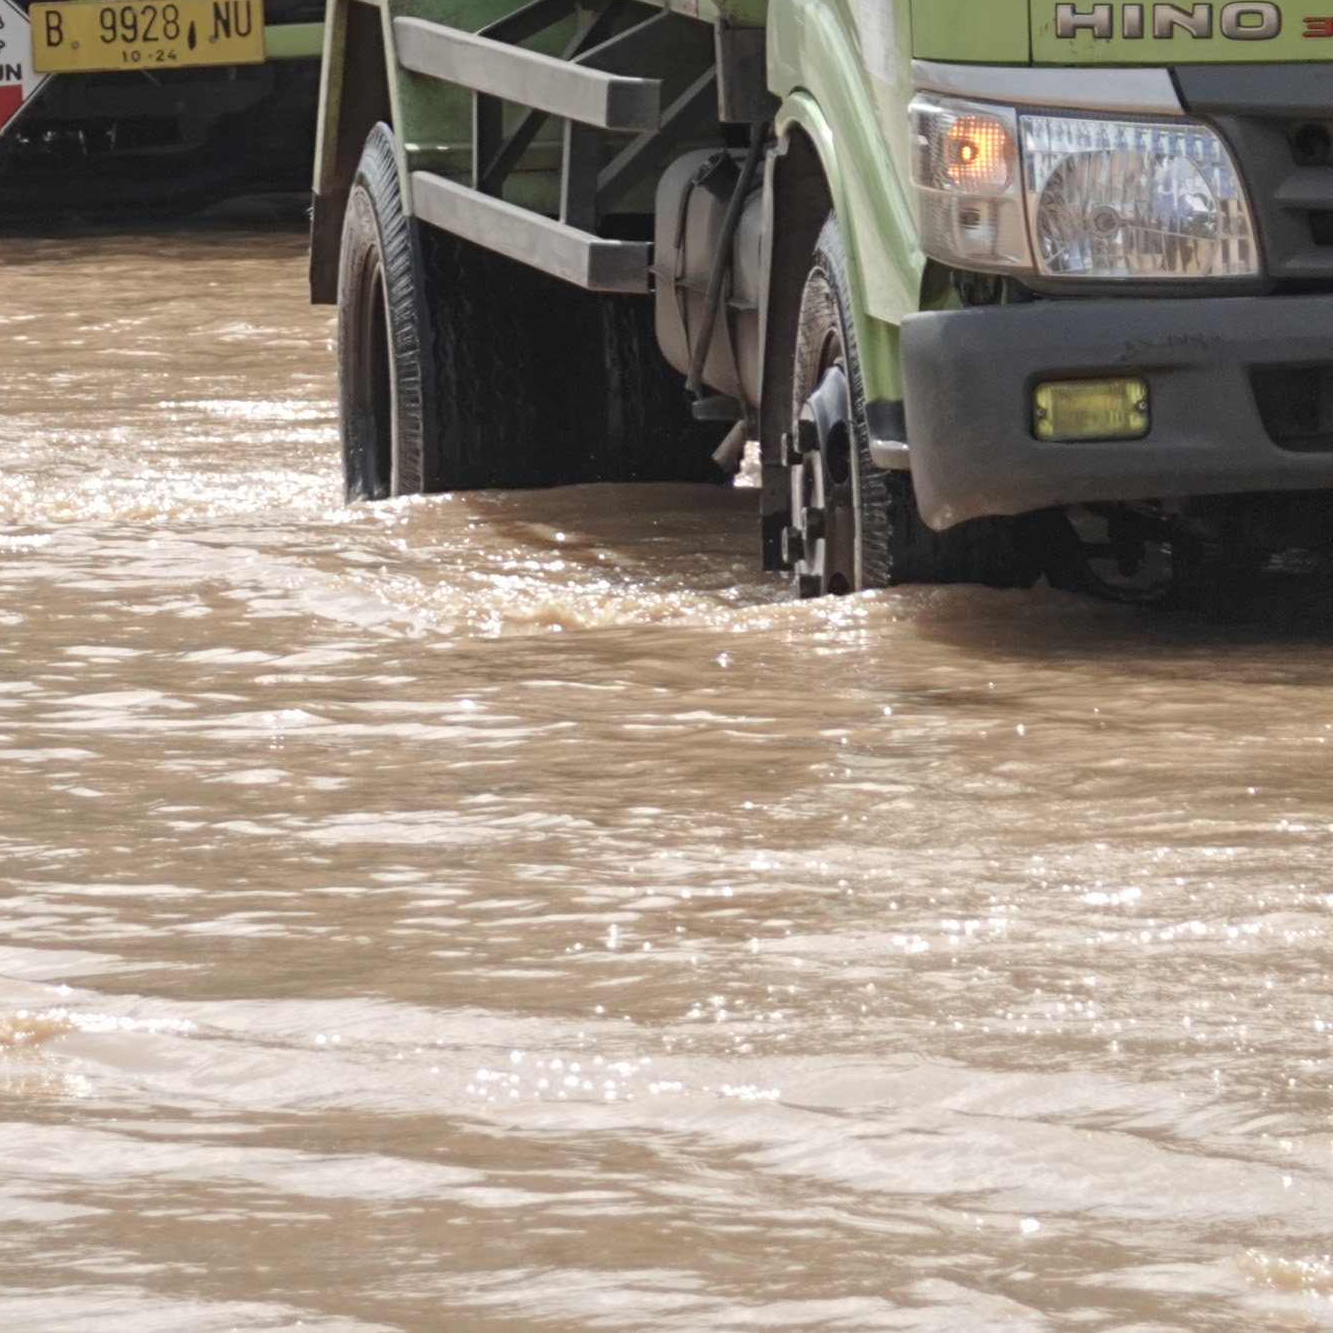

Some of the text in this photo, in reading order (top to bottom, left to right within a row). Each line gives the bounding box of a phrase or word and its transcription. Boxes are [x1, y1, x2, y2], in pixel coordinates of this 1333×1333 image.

[45, 0, 252, 48] B 9928 NU
[1055, 0, 1333, 41] HINO 3
